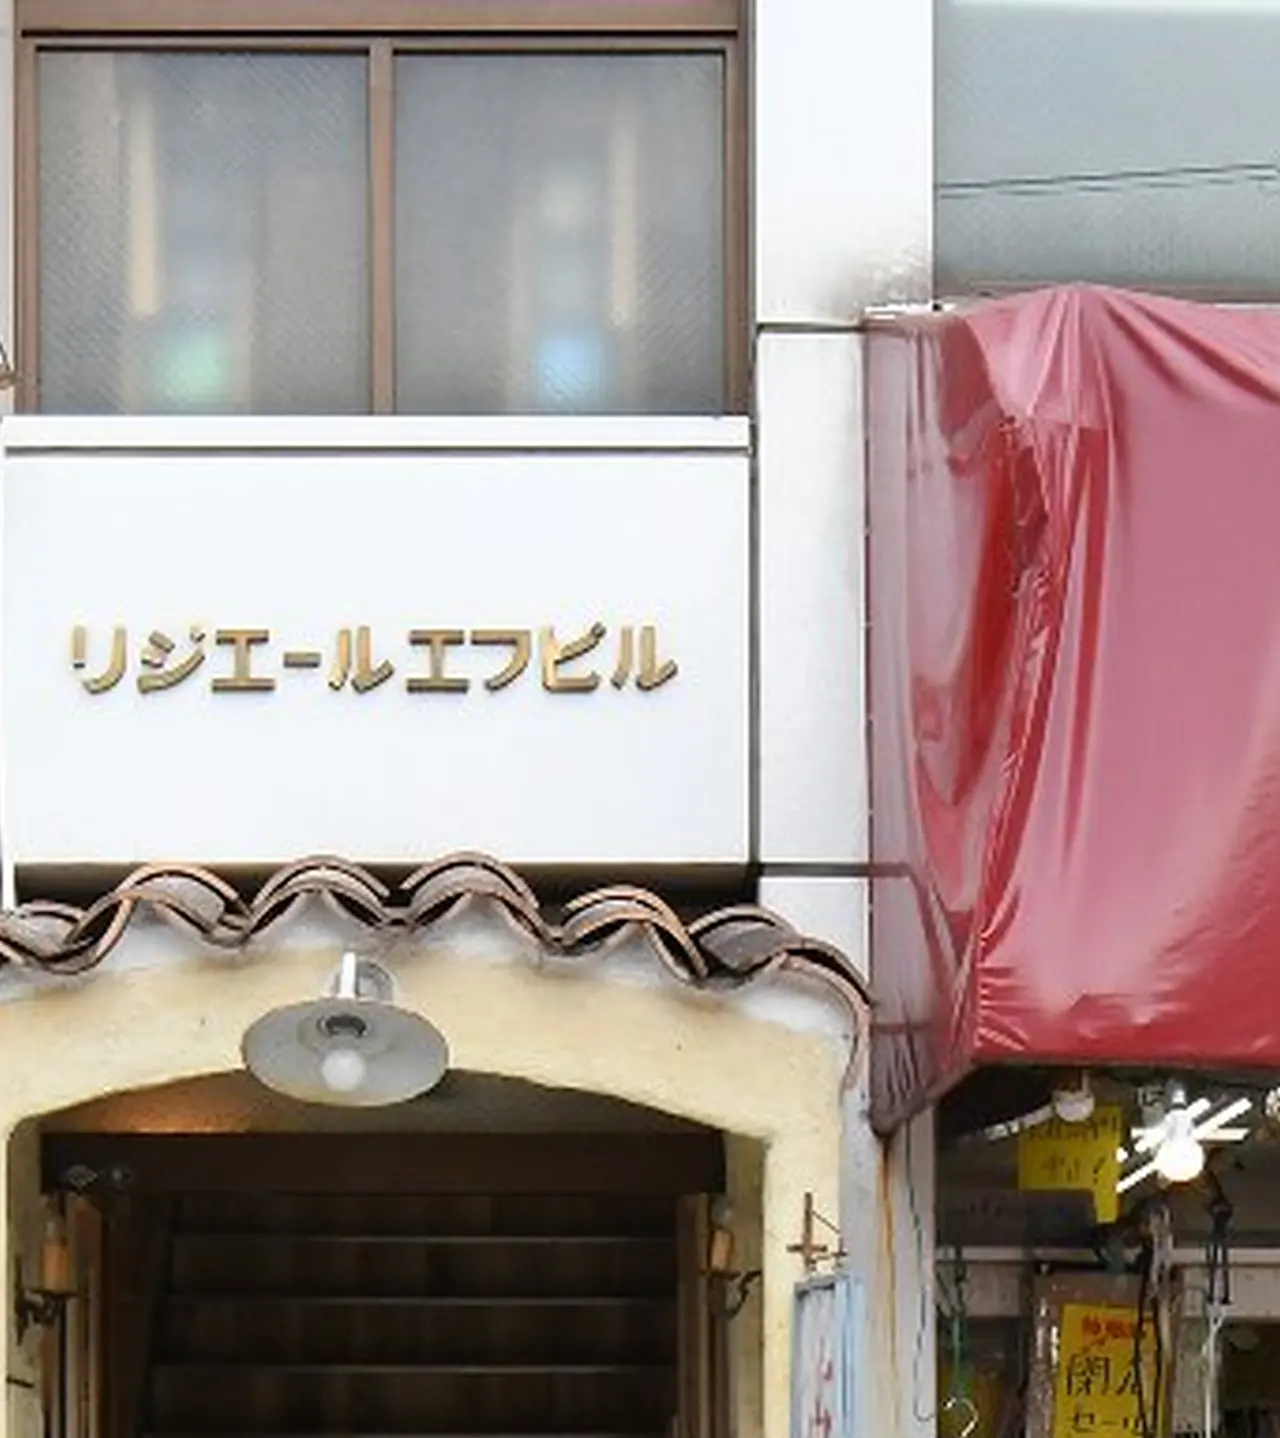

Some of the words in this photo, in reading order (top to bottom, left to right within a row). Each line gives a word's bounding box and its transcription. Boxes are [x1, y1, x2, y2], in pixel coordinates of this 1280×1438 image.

[70, 620, 678, 695] リジエールエフビル
